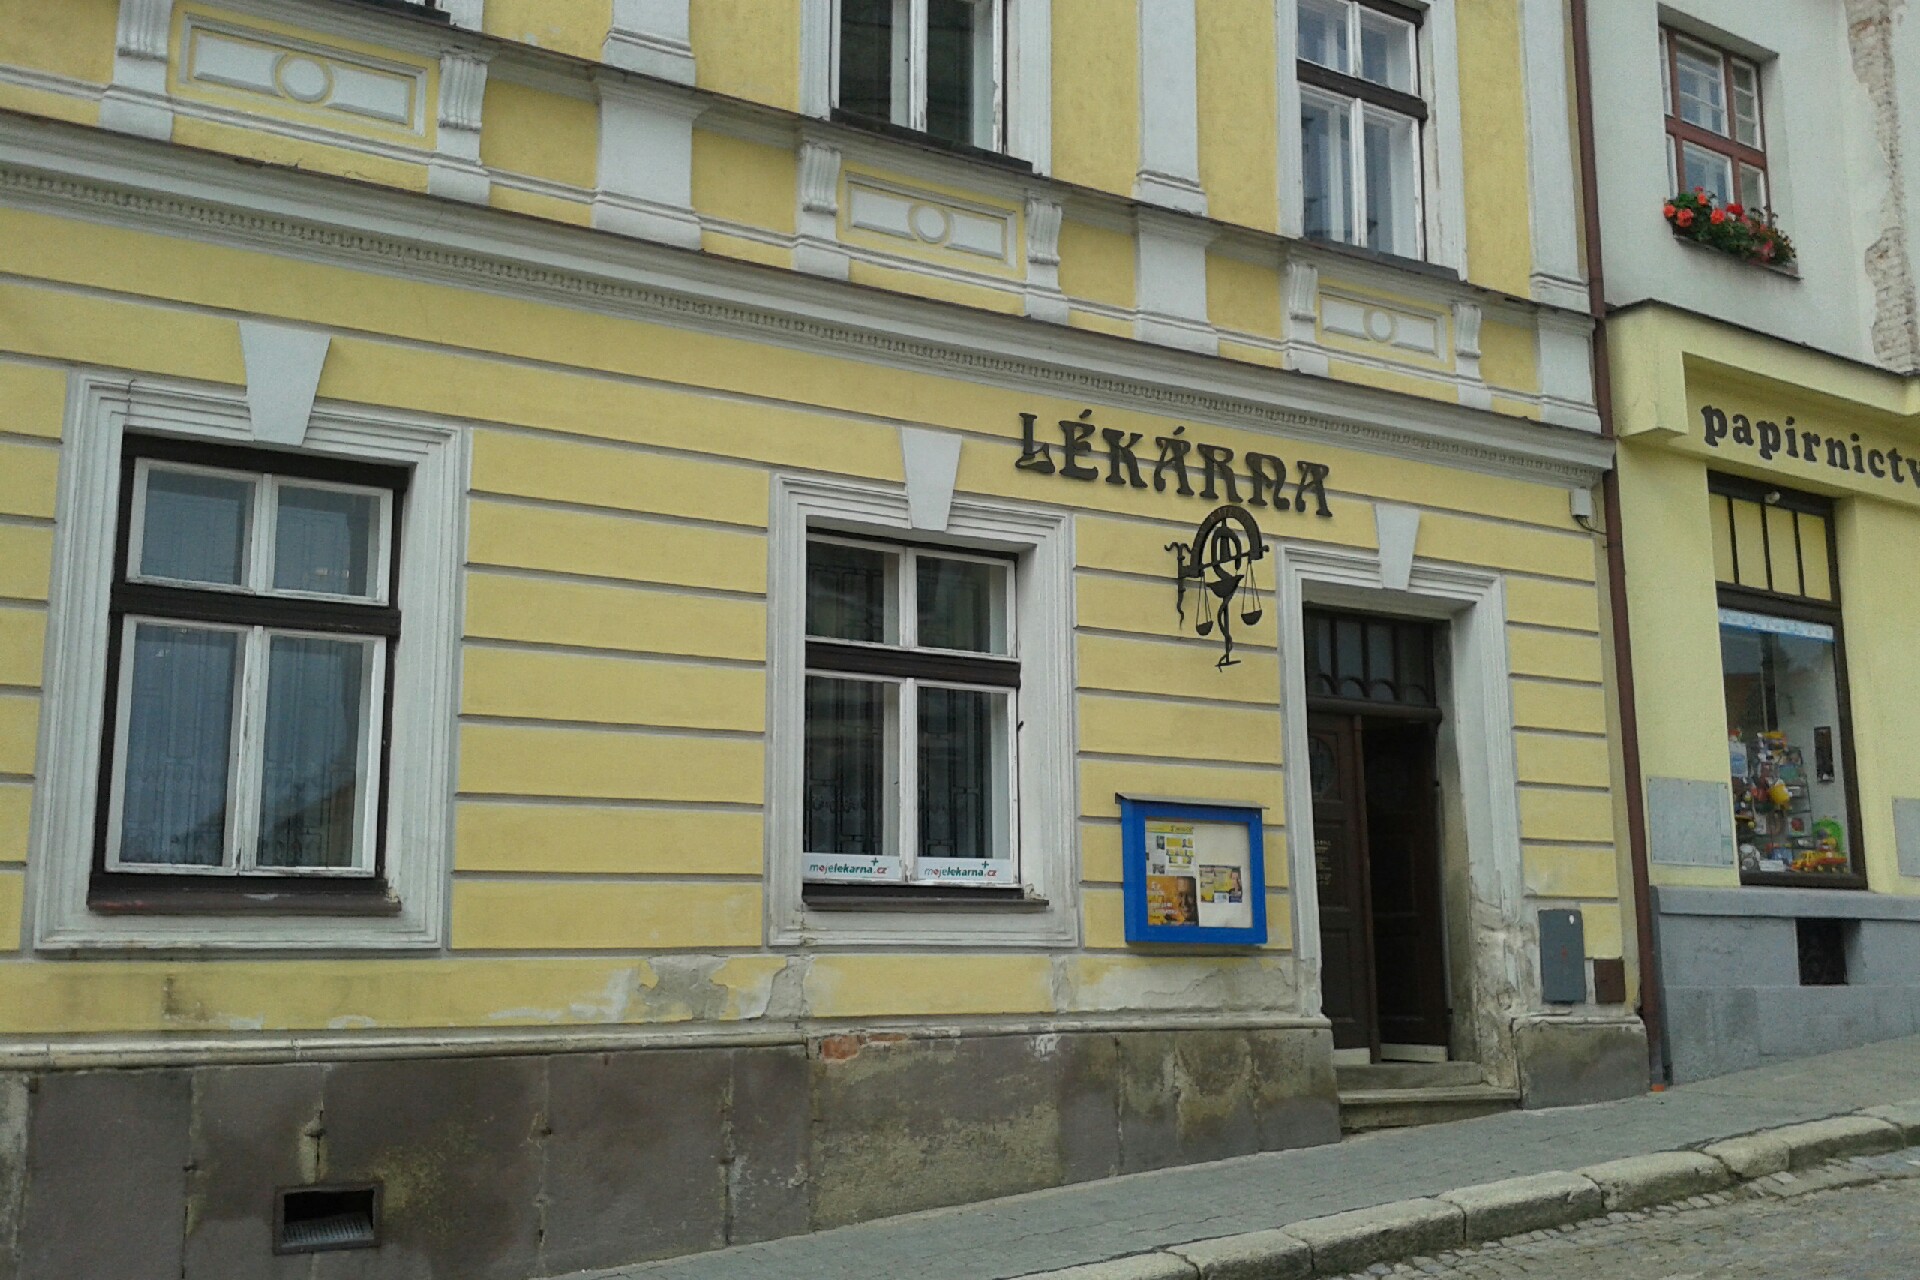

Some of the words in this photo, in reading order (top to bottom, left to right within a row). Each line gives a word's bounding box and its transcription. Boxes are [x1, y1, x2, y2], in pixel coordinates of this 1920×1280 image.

[1015, 409, 1333, 517] LÉKÁRNA
[809, 862, 888, 875] mojelekarna.cz
[924, 866, 997, 878] mojelekarna.cz
